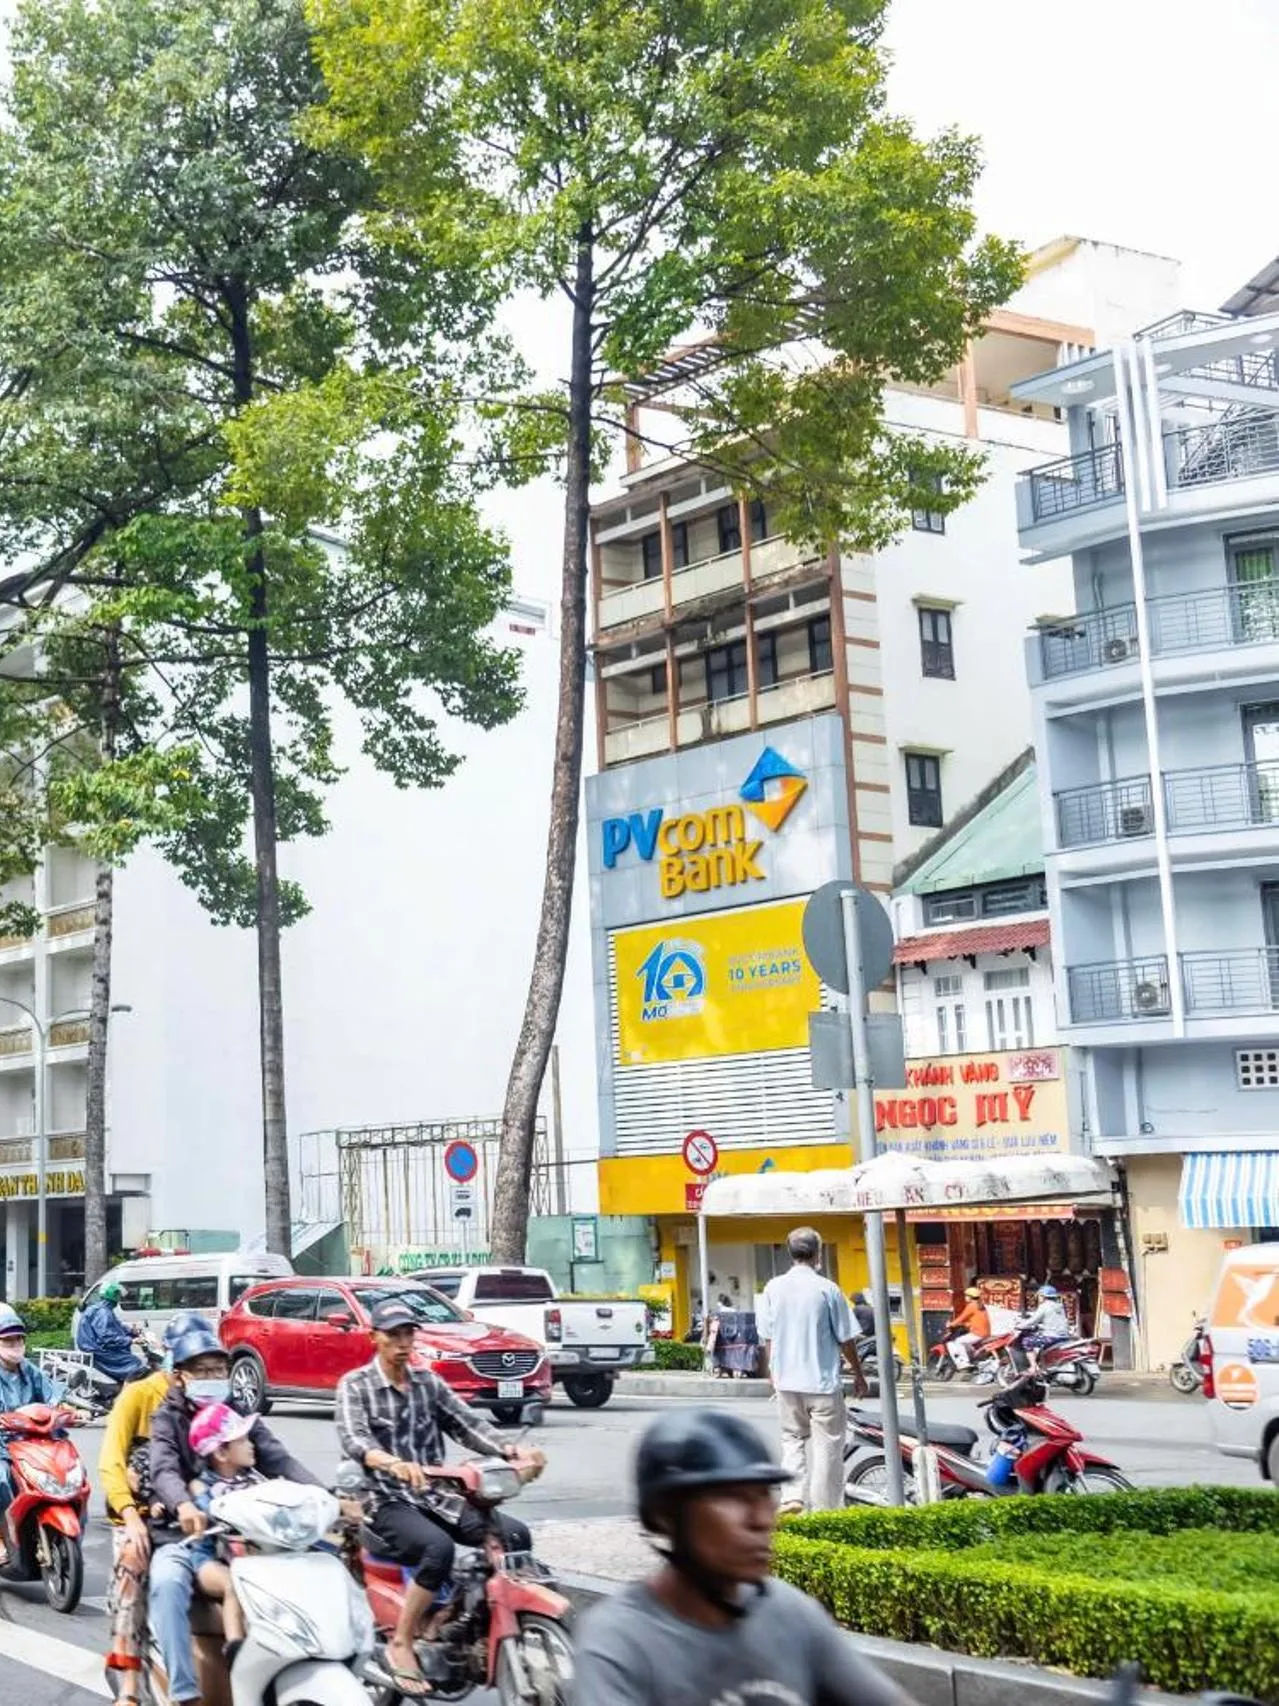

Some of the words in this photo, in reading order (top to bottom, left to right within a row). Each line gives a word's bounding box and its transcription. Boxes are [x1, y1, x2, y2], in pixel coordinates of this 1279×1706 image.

[659, 841, 766, 899] Bank
[749, 959, 801, 979] YEARS
[875, 1096, 958, 1131] NGỌC
[974, 1084, 1036, 1127] MỸ
